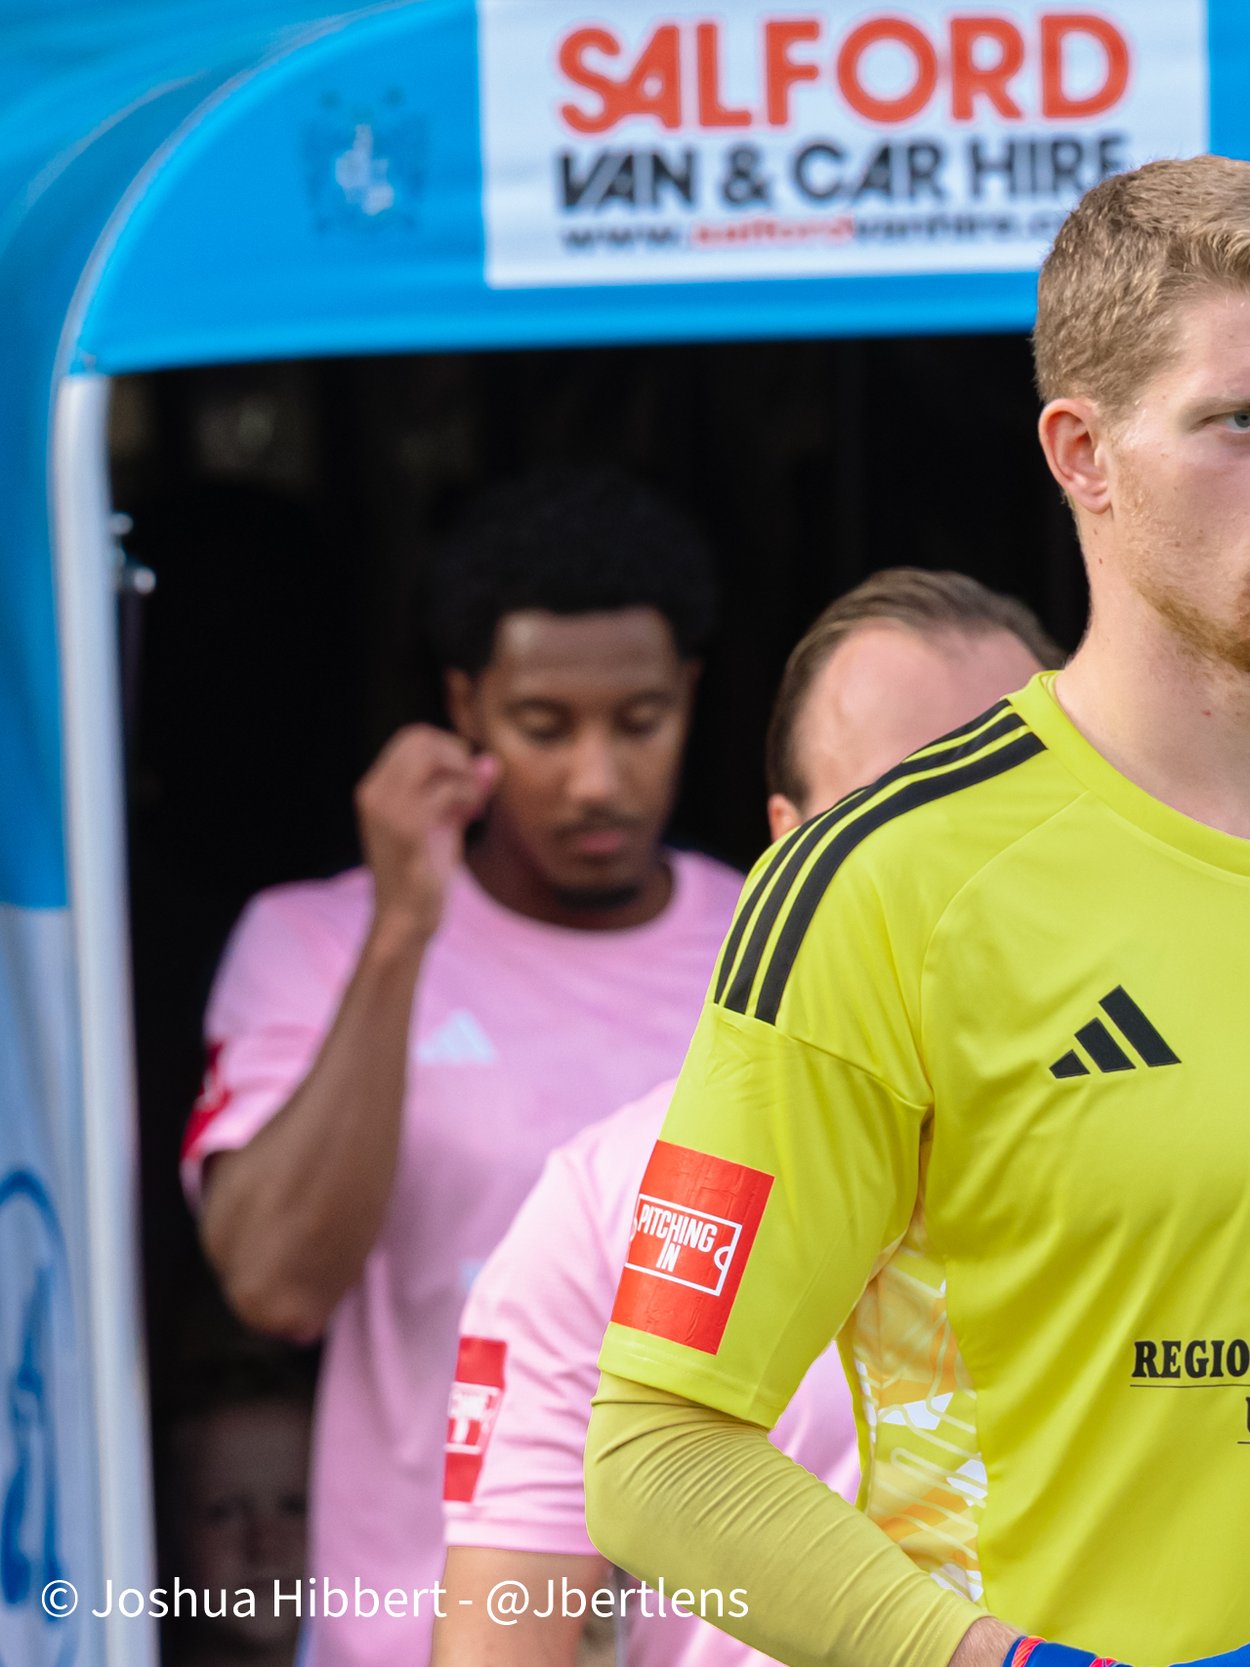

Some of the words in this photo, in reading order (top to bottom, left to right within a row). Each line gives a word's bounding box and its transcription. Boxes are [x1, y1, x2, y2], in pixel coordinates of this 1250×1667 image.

[558, 13, 1130, 133] SALFORD
[558, 147, 696, 211] VAN
[721, 143, 770, 208] &
[797, 139, 946, 204] CAR
[637, 1203, 718, 1253] PITCHING
[655, 1236, 682, 1273] IN
